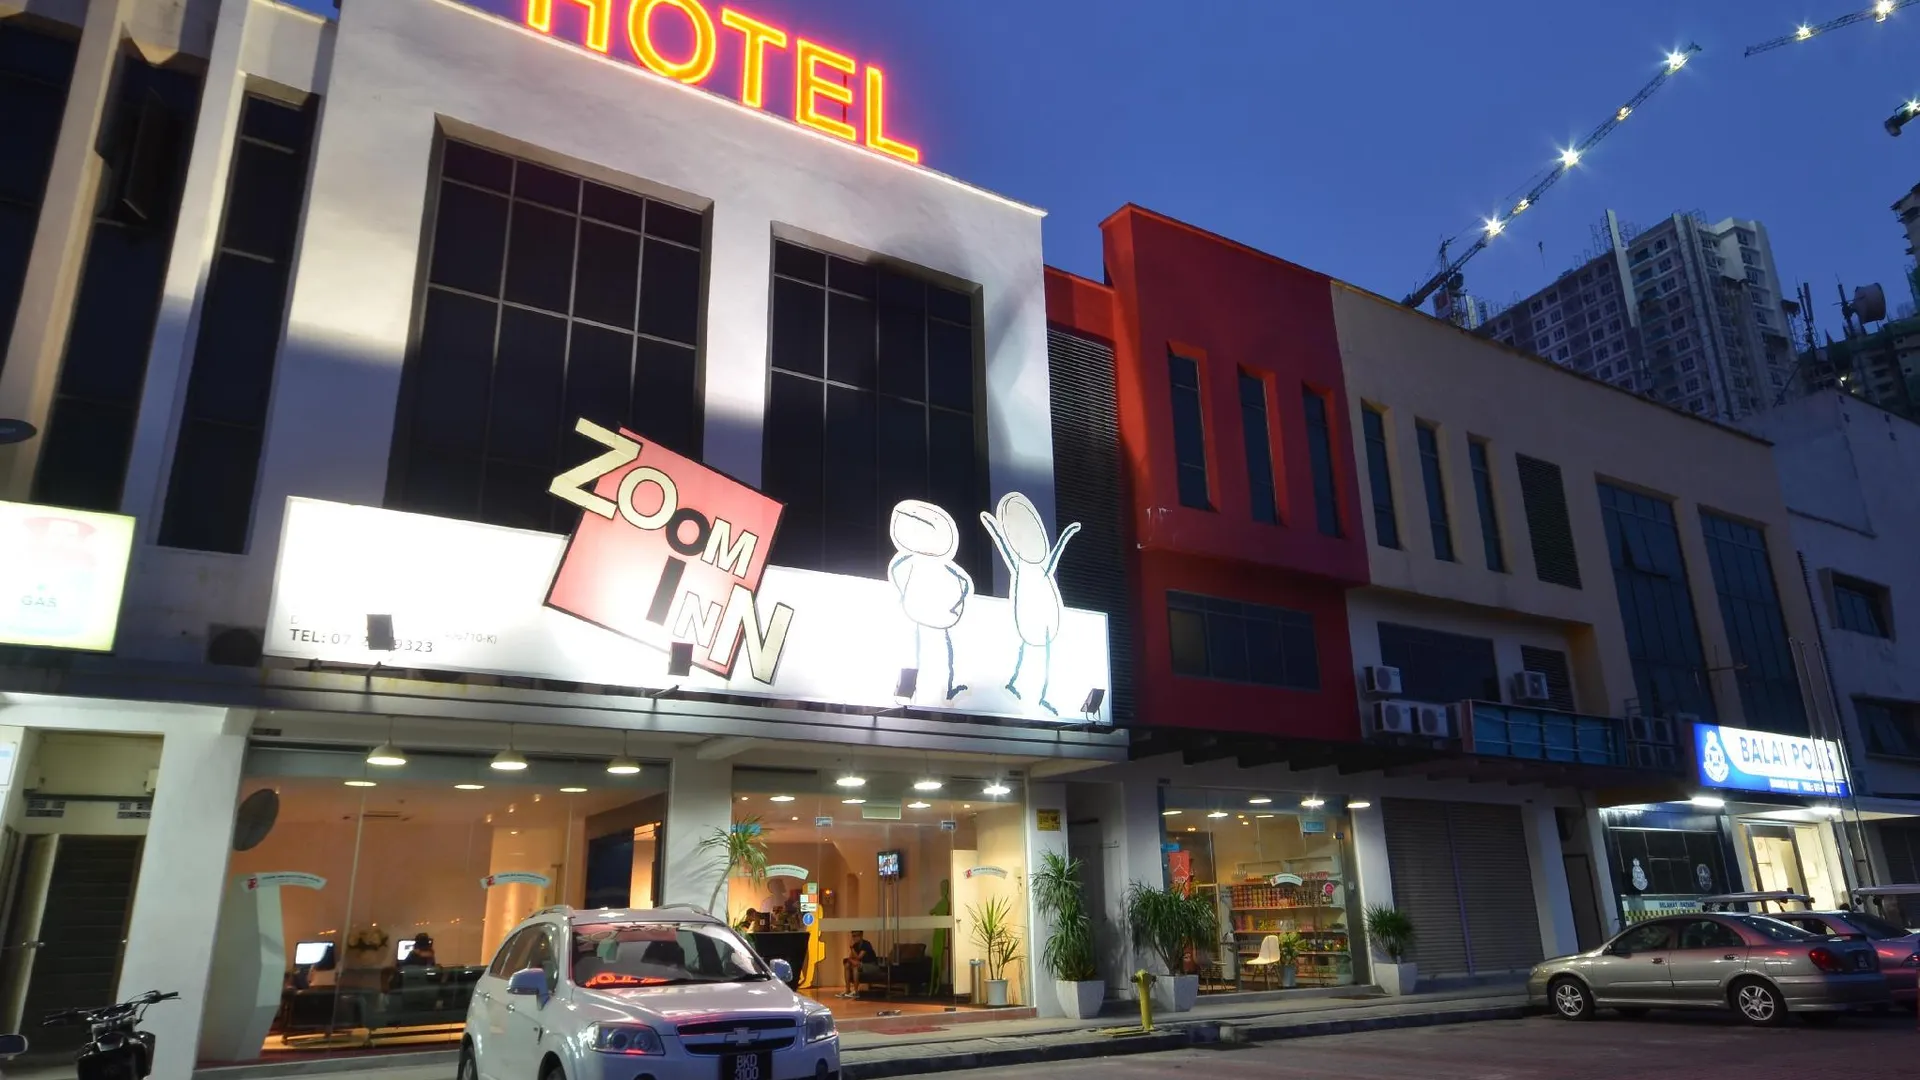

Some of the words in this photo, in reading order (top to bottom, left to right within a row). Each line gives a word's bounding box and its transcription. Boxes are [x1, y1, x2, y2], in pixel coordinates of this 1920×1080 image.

[21, 595, 57, 608] GAS
[289, 628, 326, 643] TEL:
[1739, 736, 1788, 767] BALAI
